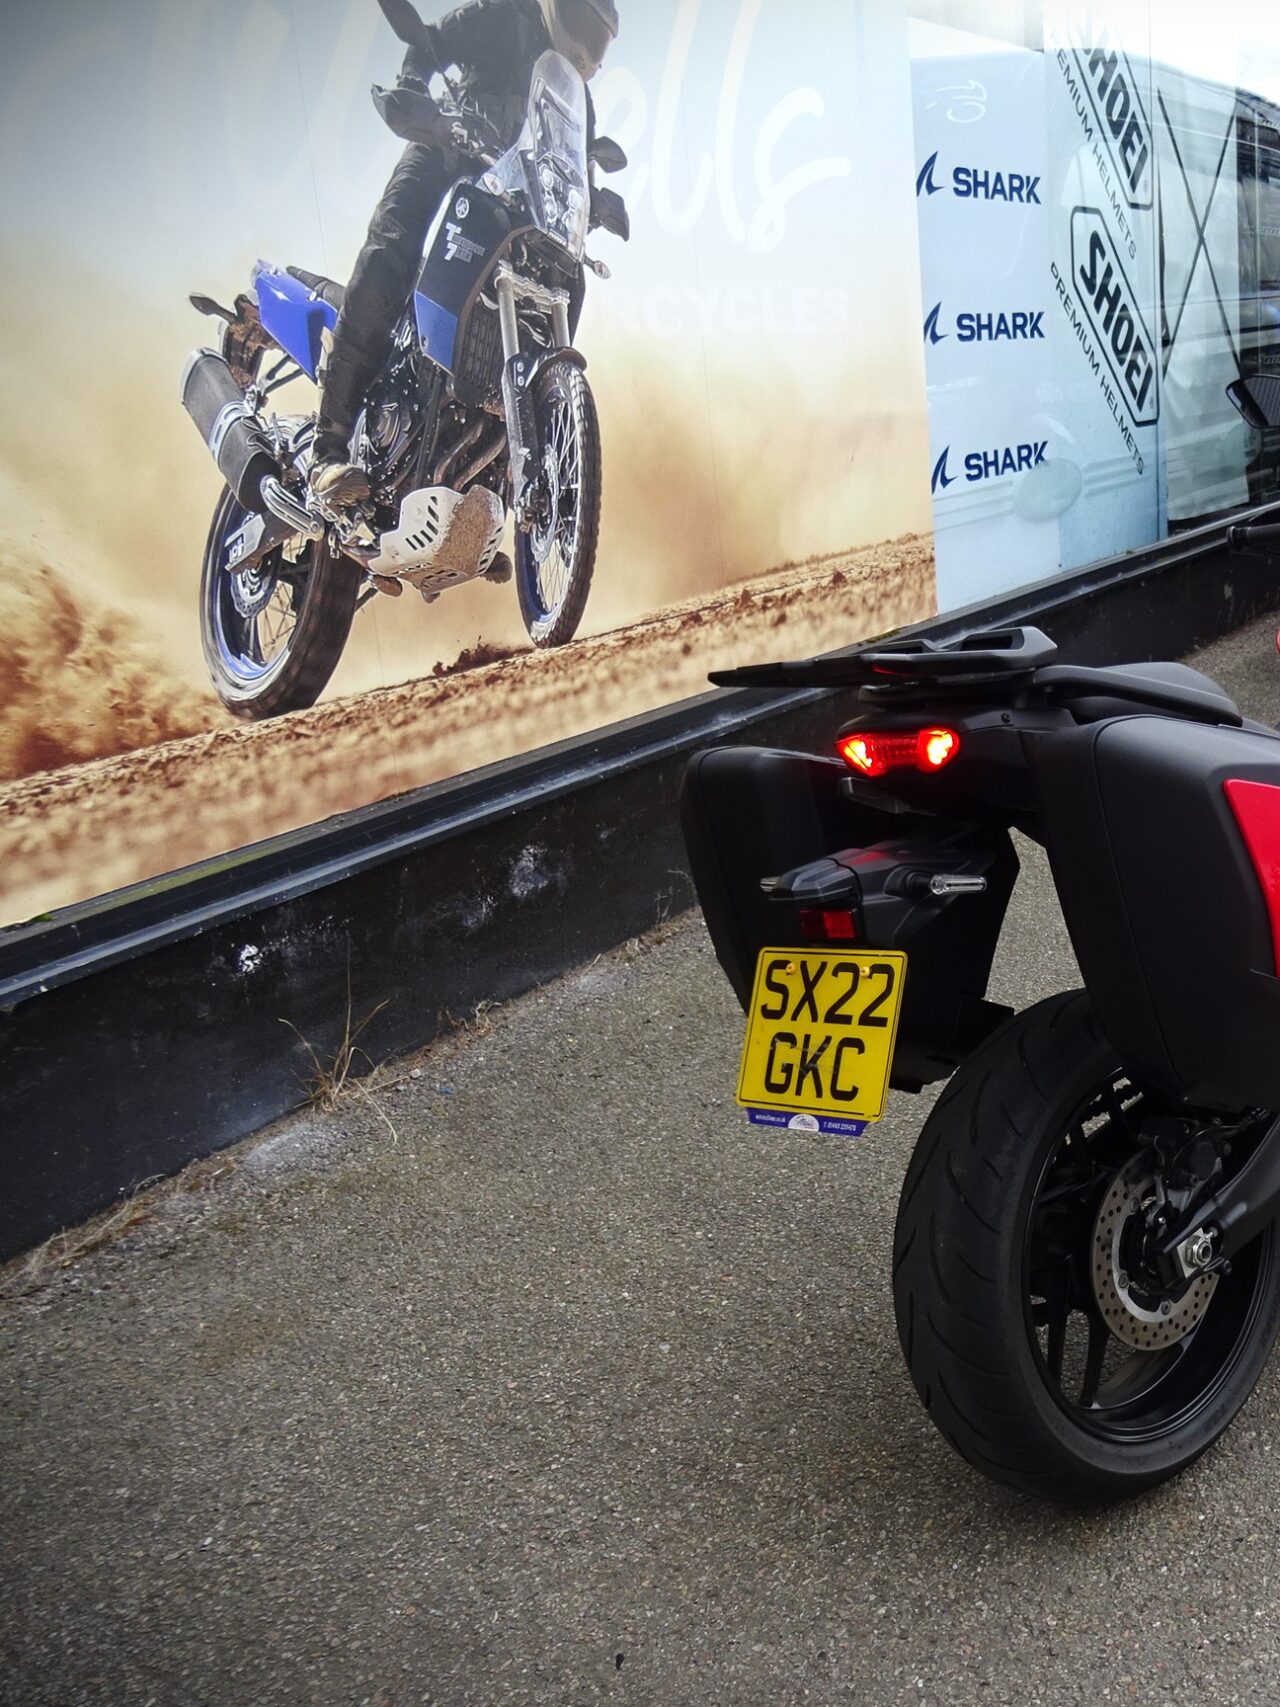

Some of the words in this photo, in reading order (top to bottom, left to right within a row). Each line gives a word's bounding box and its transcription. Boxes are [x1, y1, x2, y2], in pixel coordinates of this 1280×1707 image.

[952, 166, 1042, 204] SHARK
[1092, 142, 1137, 261] HELMETS
[956, 310, 1046, 343] SHARK
[1080, 230, 1154, 413] SHOEI
[1051, 261, 1100, 377] PREMIUM
[1099, 375, 1145, 476] HELMETS
[964, 440, 1049, 482] SHARK
[760, 958, 896, 1028] SX22
[763, 1031, 866, 1102] GKC
